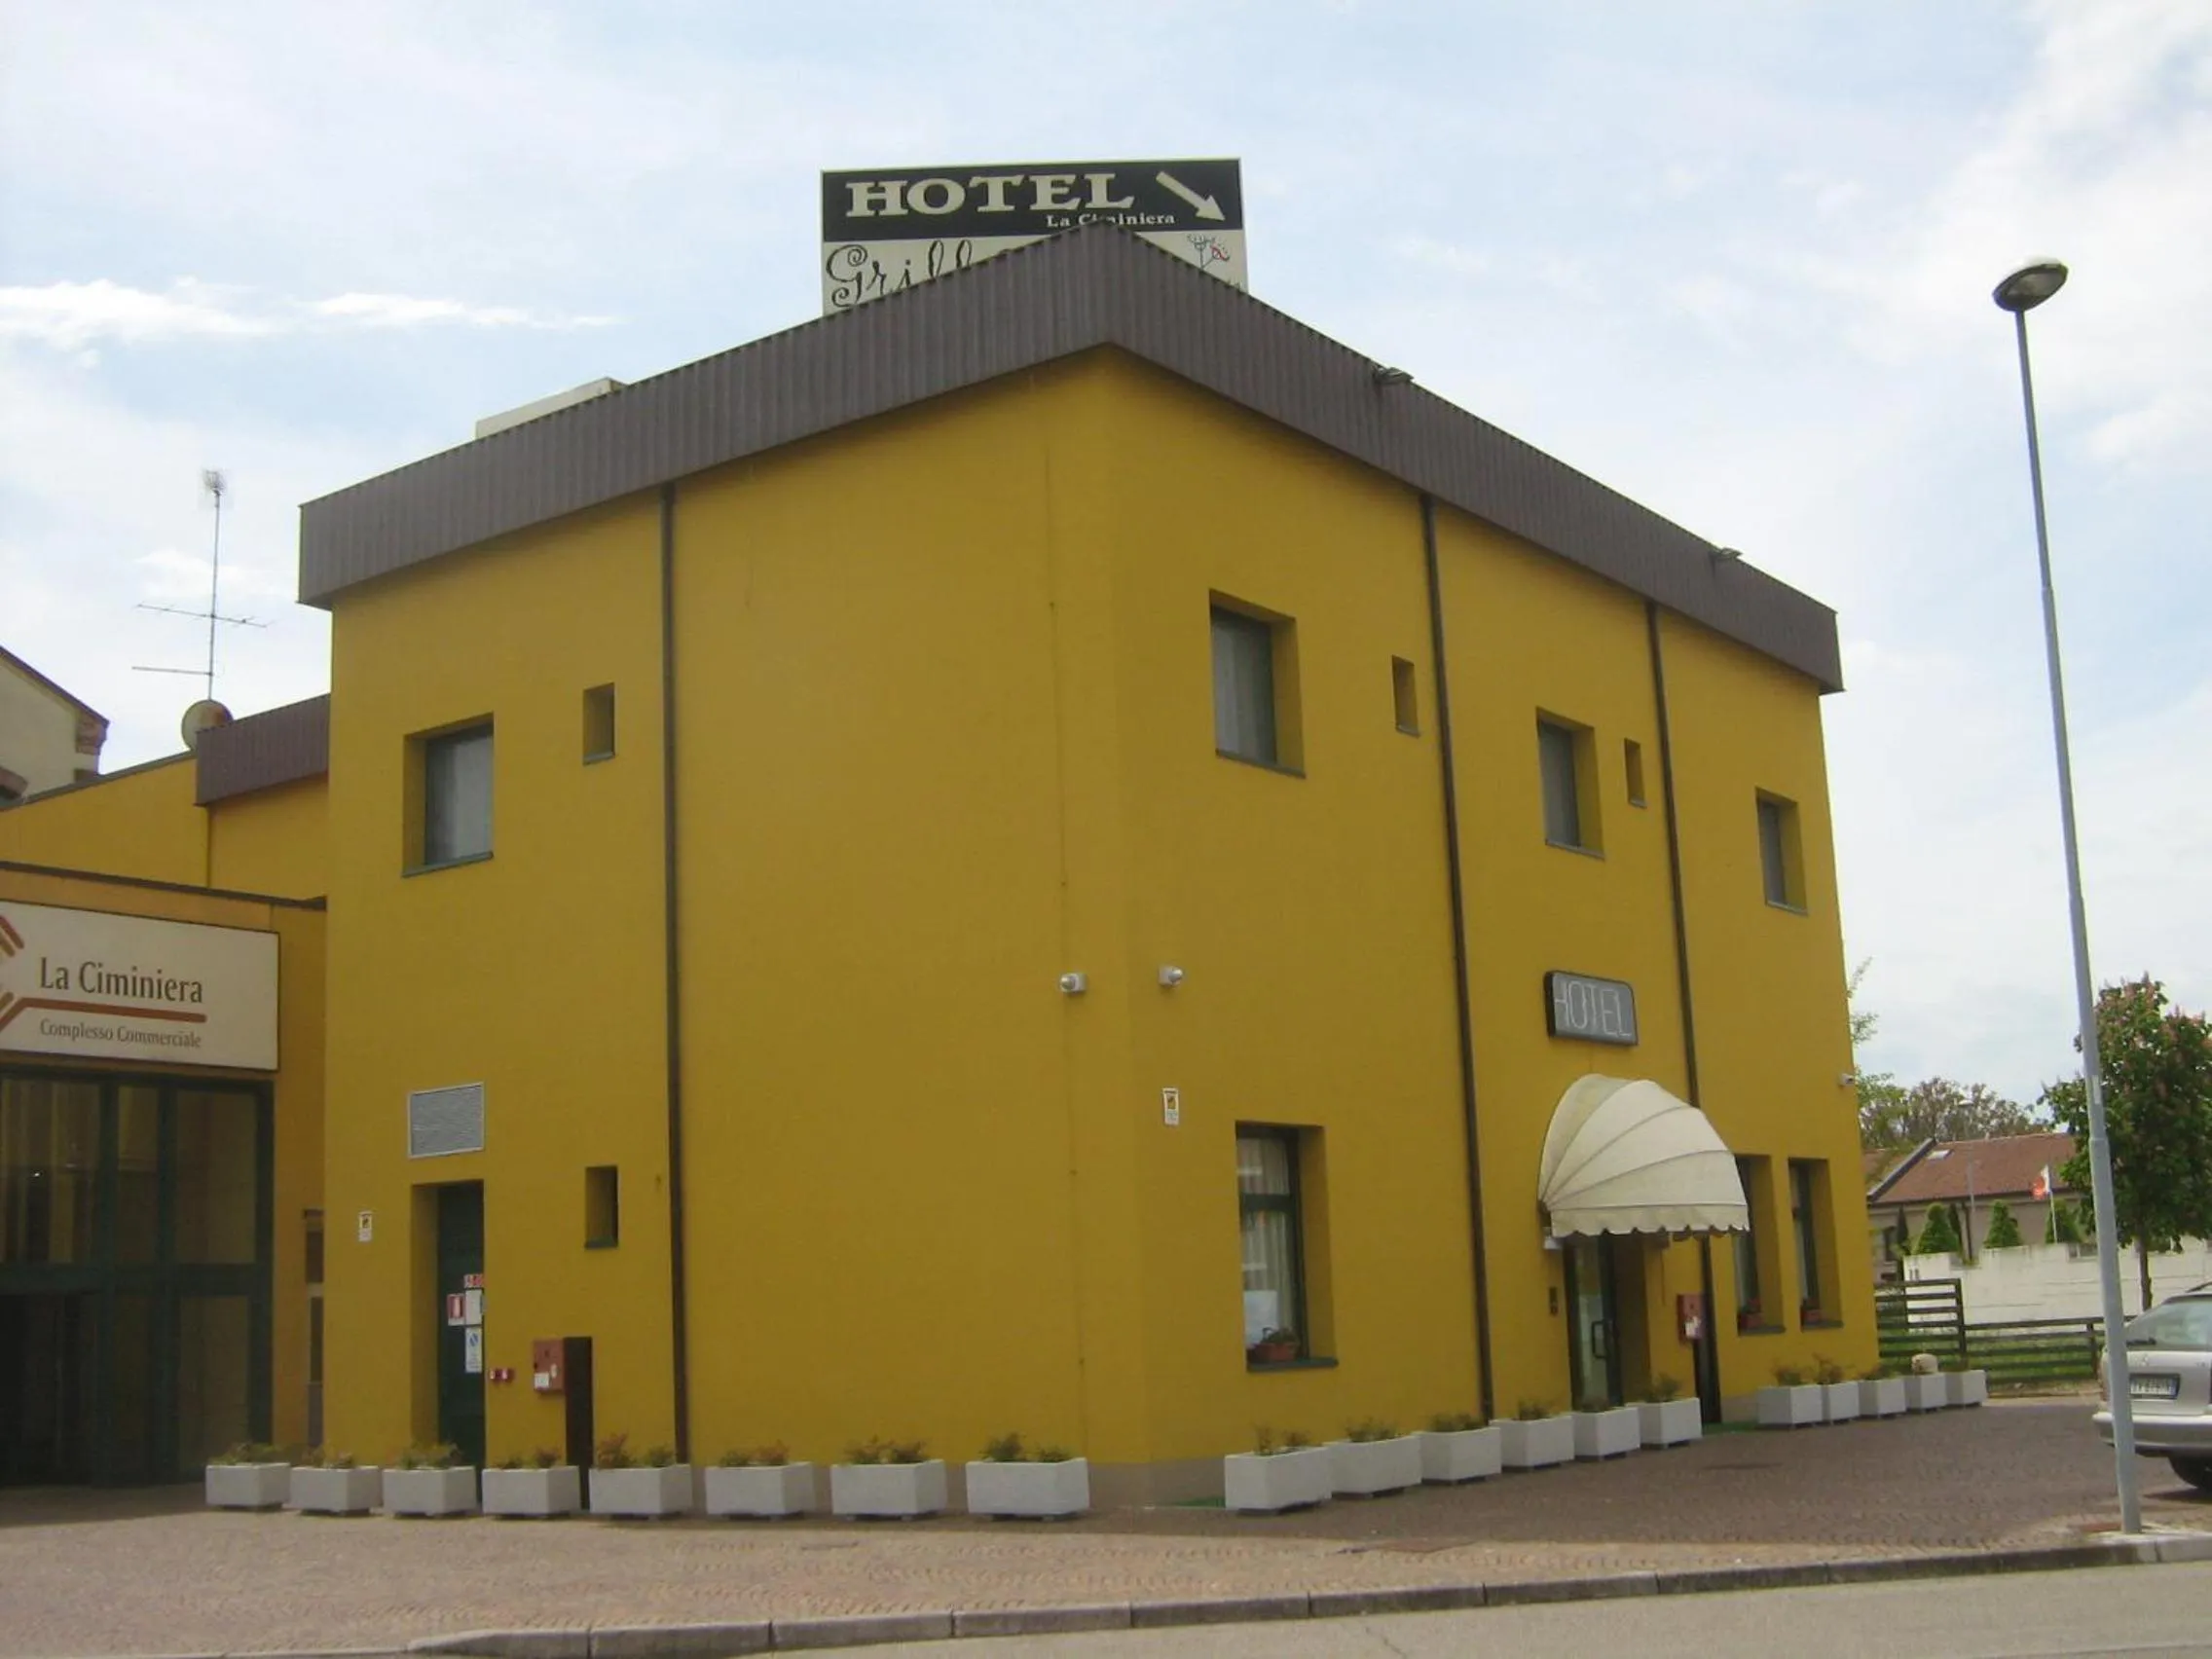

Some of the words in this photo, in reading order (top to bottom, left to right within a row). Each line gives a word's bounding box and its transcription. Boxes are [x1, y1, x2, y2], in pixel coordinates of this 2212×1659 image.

[846, 172, 1135, 217] HOTEL
[1046, 214, 1071, 228] La
[39, 956, 69, 991] La
[78, 960, 203, 1004] Ciminiera
[39, 1018, 114, 1042] Complesso
[116, 1025, 202, 1049] Commerciale
